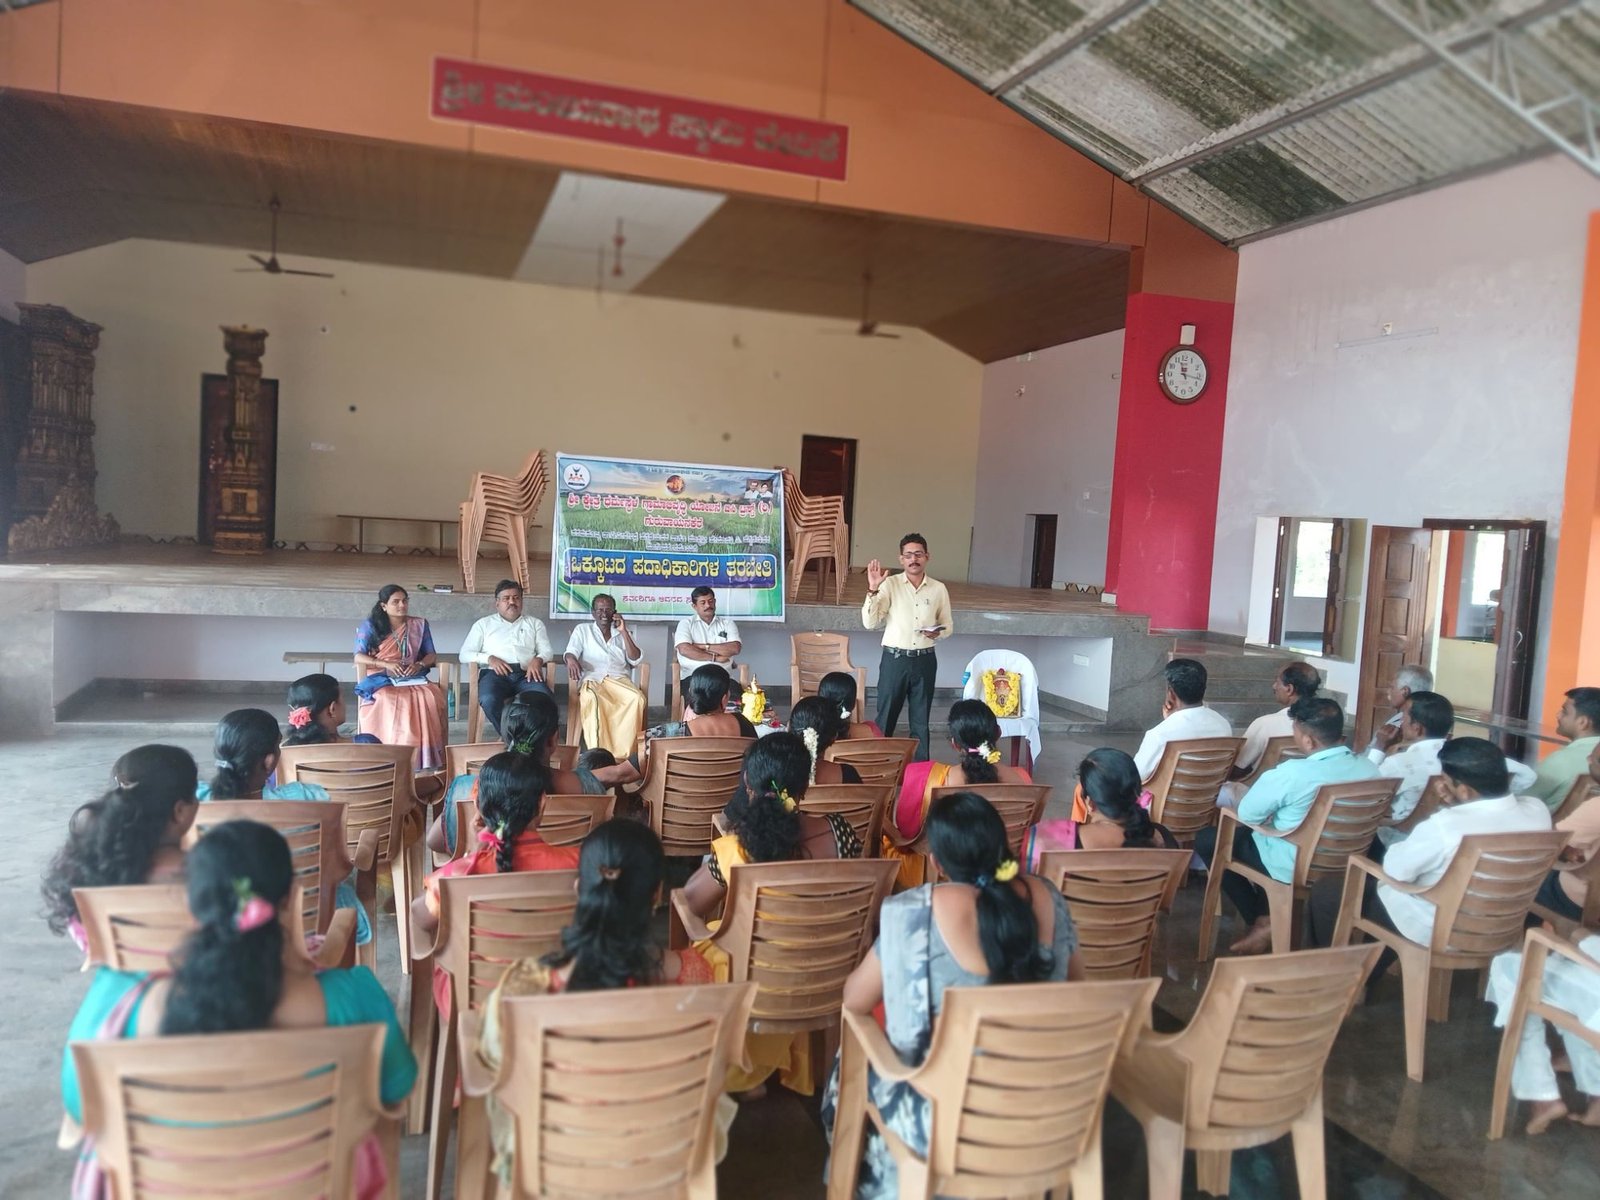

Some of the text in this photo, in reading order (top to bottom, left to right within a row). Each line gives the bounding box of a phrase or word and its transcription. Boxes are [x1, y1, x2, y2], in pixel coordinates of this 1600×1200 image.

[571, 553, 772, 583] ಒಕ್ಕೂಟದ ಪದಾಧಿಕಾರಿಗಳ ತರಬೇತಿ
